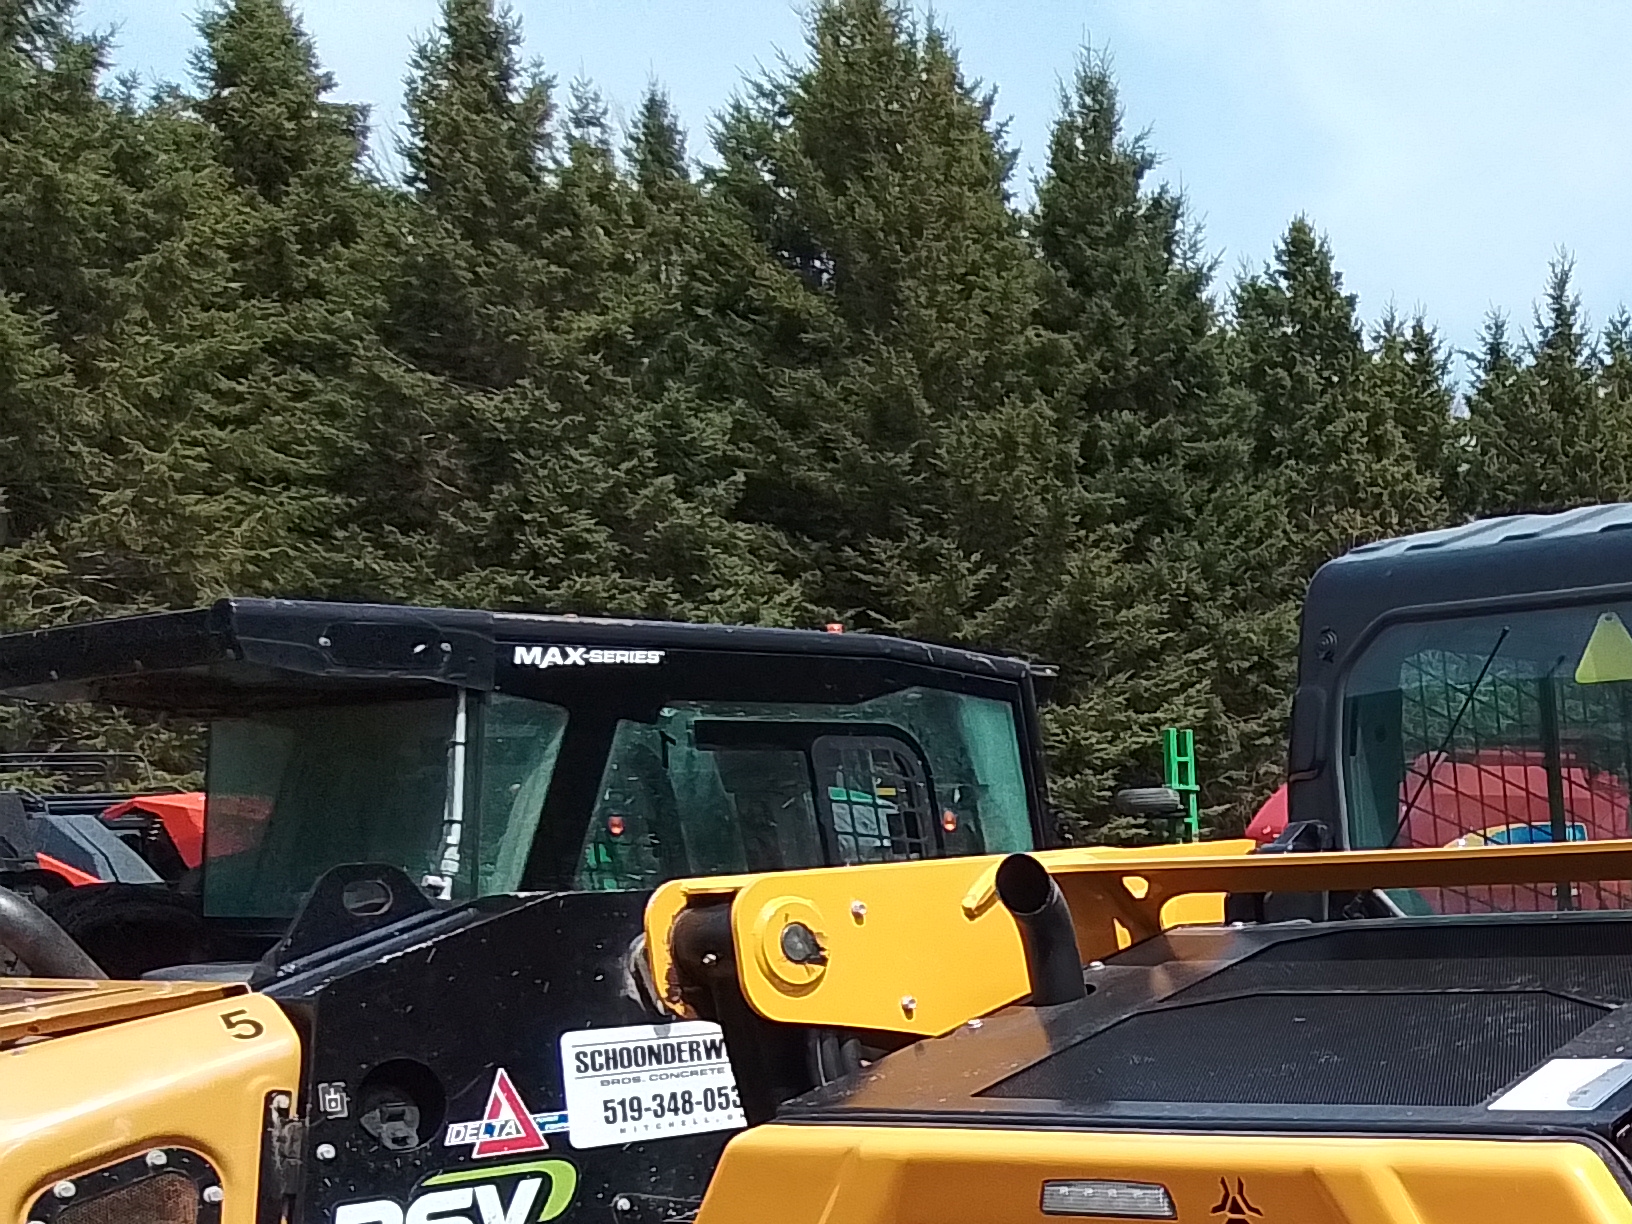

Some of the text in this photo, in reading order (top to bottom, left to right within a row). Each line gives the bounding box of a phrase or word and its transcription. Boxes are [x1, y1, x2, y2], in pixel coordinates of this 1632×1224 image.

[220, 1009, 264, 1040] 5
[574, 1038, 729, 1074] SCHOONDERW
[648, 1066, 726, 1082] CONCRETE
[448, 1119, 518, 1143] DELTA
